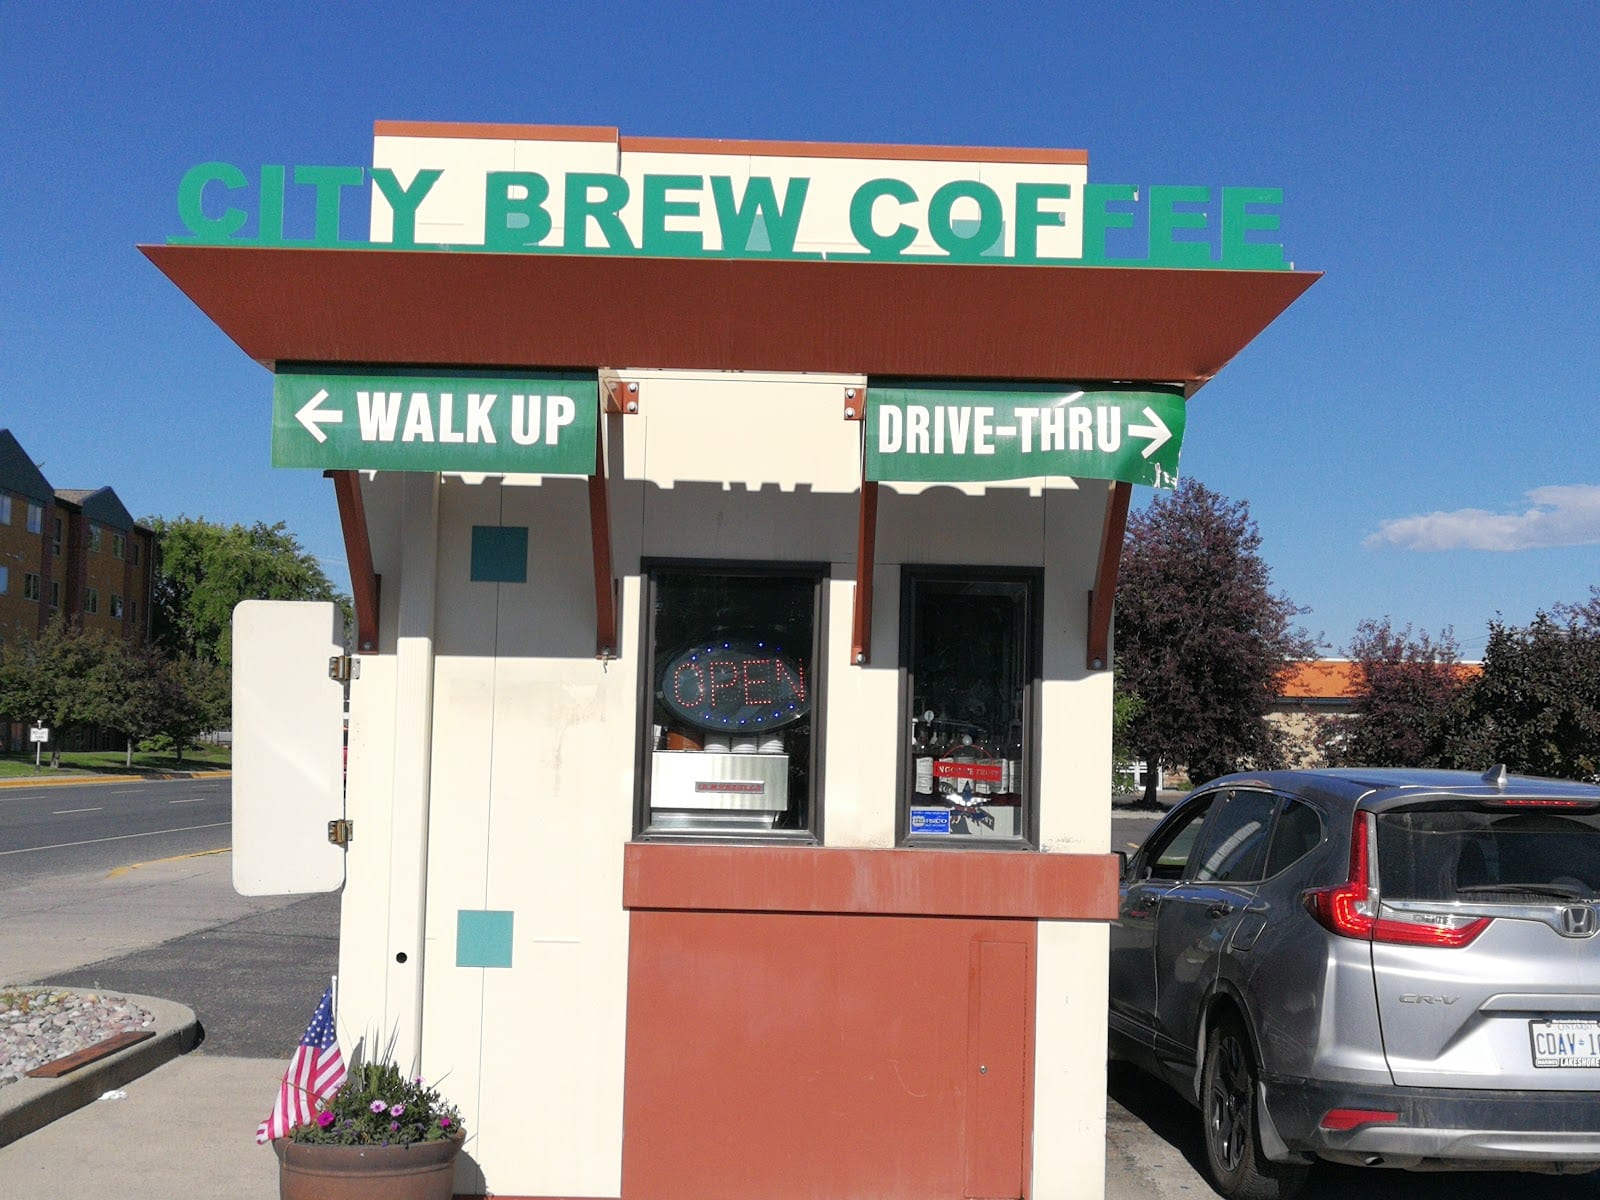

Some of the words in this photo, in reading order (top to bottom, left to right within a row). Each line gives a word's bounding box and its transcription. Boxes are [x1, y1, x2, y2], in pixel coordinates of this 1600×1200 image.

[176, 161, 444, 244] CITY
[485, 170, 810, 255] BREW
[849, 178, 1284, 265] COFFEE
[356, 391, 497, 443] WALK
[511, 395, 576, 445] UP
[878, 404, 1121, 454] DRIVE-THRU
[674, 658, 805, 707] OPEN
[1399, 994, 1460, 1005] CR-V
